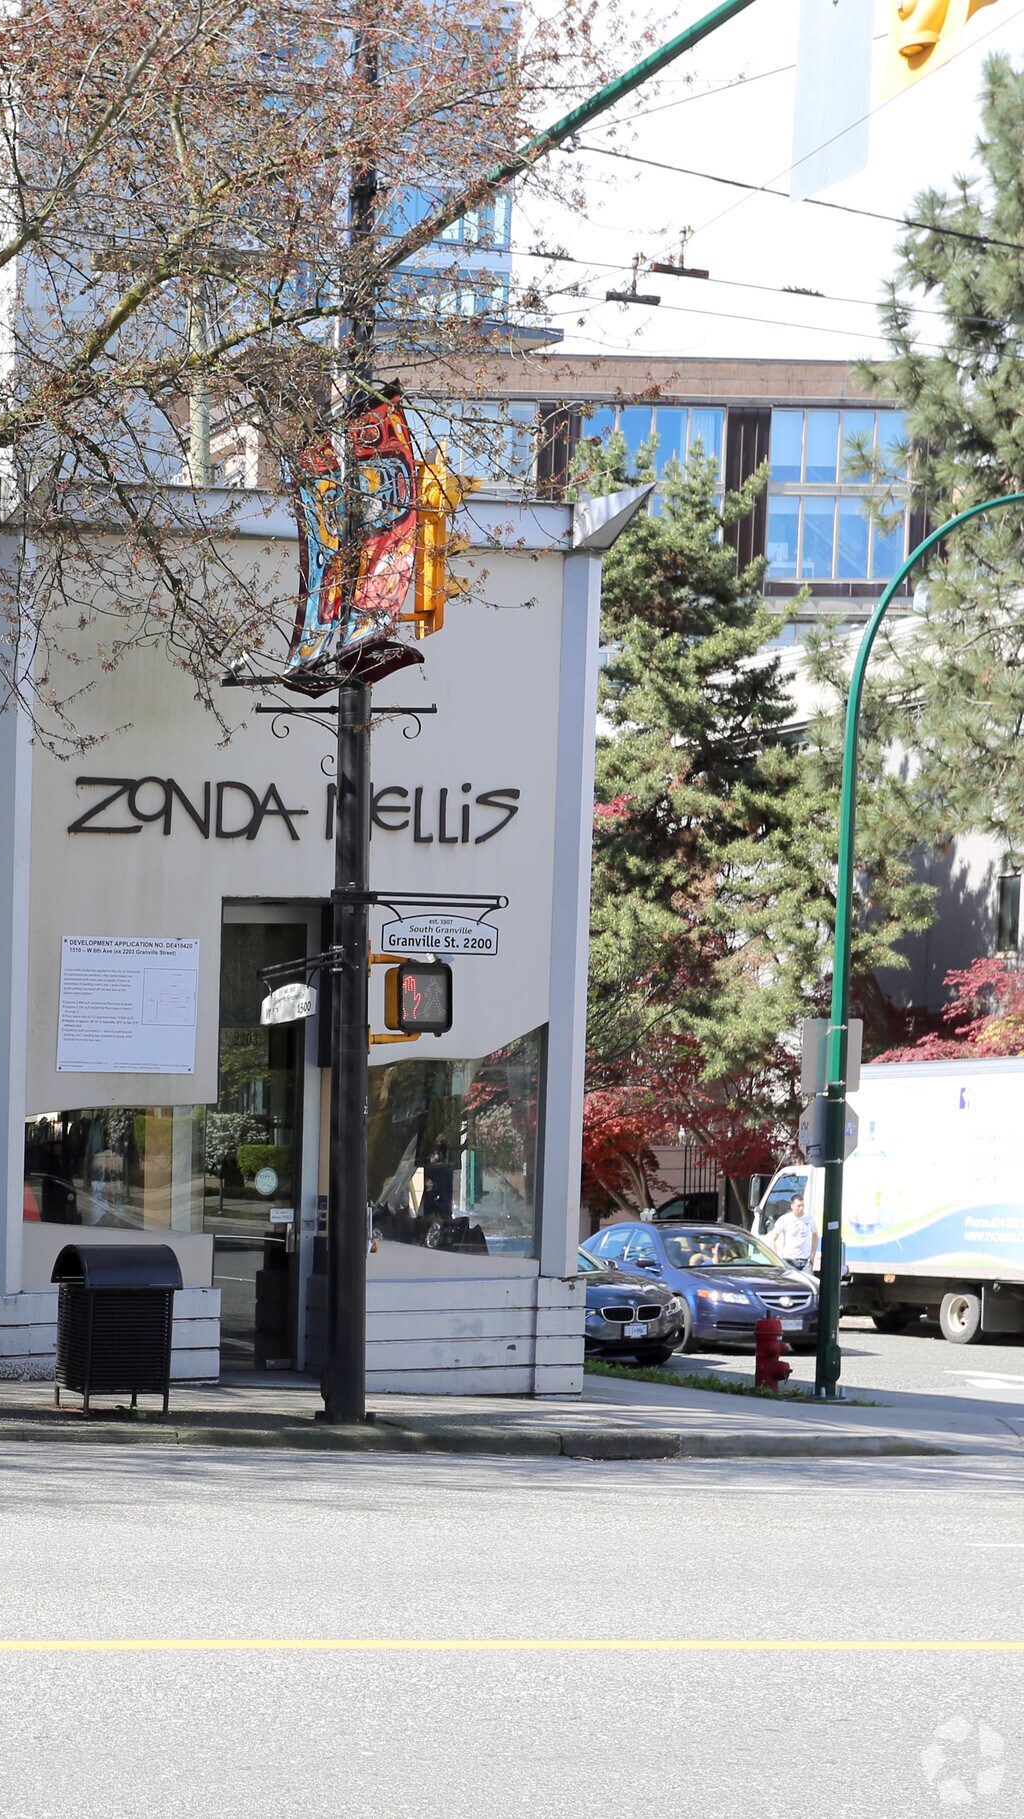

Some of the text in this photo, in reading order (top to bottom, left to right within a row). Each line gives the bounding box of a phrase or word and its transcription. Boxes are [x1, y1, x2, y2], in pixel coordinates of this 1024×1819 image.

[68, 776, 309, 841] ZONDA
[409, 925, 473, 935] South Granville
[388, 934, 492, 949] Granville St. 2200
[296, 1001, 312, 1014] 1500
[233, 1032, 258, 1046] 2203
